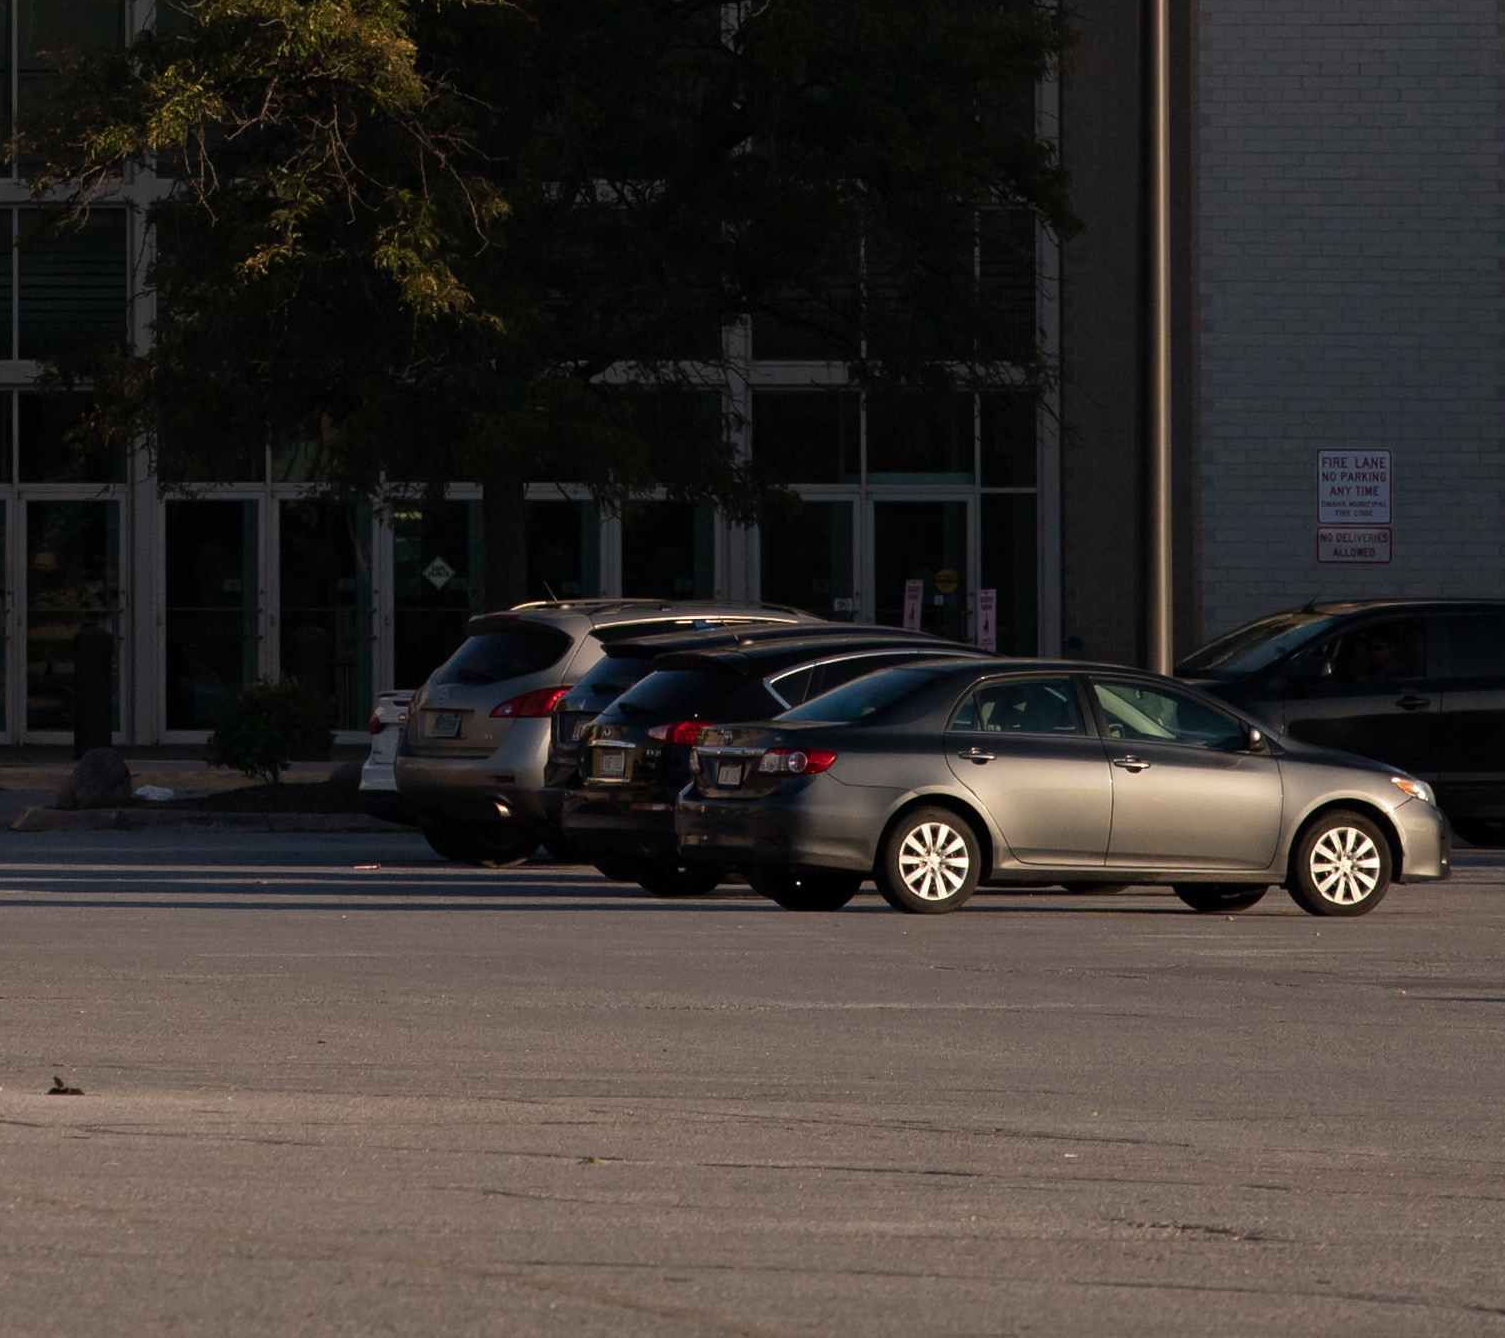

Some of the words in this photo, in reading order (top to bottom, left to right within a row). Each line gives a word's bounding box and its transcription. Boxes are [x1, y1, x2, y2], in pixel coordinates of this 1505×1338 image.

[1321, 456, 1348, 469] FIRE
[1354, 456, 1387, 469] LANE
[1321, 471, 1337, 483] NO
[1340, 471, 1387, 483] PARKING
[1329, 486, 1352, 497] ANY
[1355, 486, 1380, 497] TIME
[1335, 509, 1351, 517] FIRE
[1353, 509, 1374, 517] CODE
[1319, 532, 1333, 543] NO
[1335, 532, 1389, 543] DELIVERIES
[1332, 547, 1376, 558] ALLOWED
